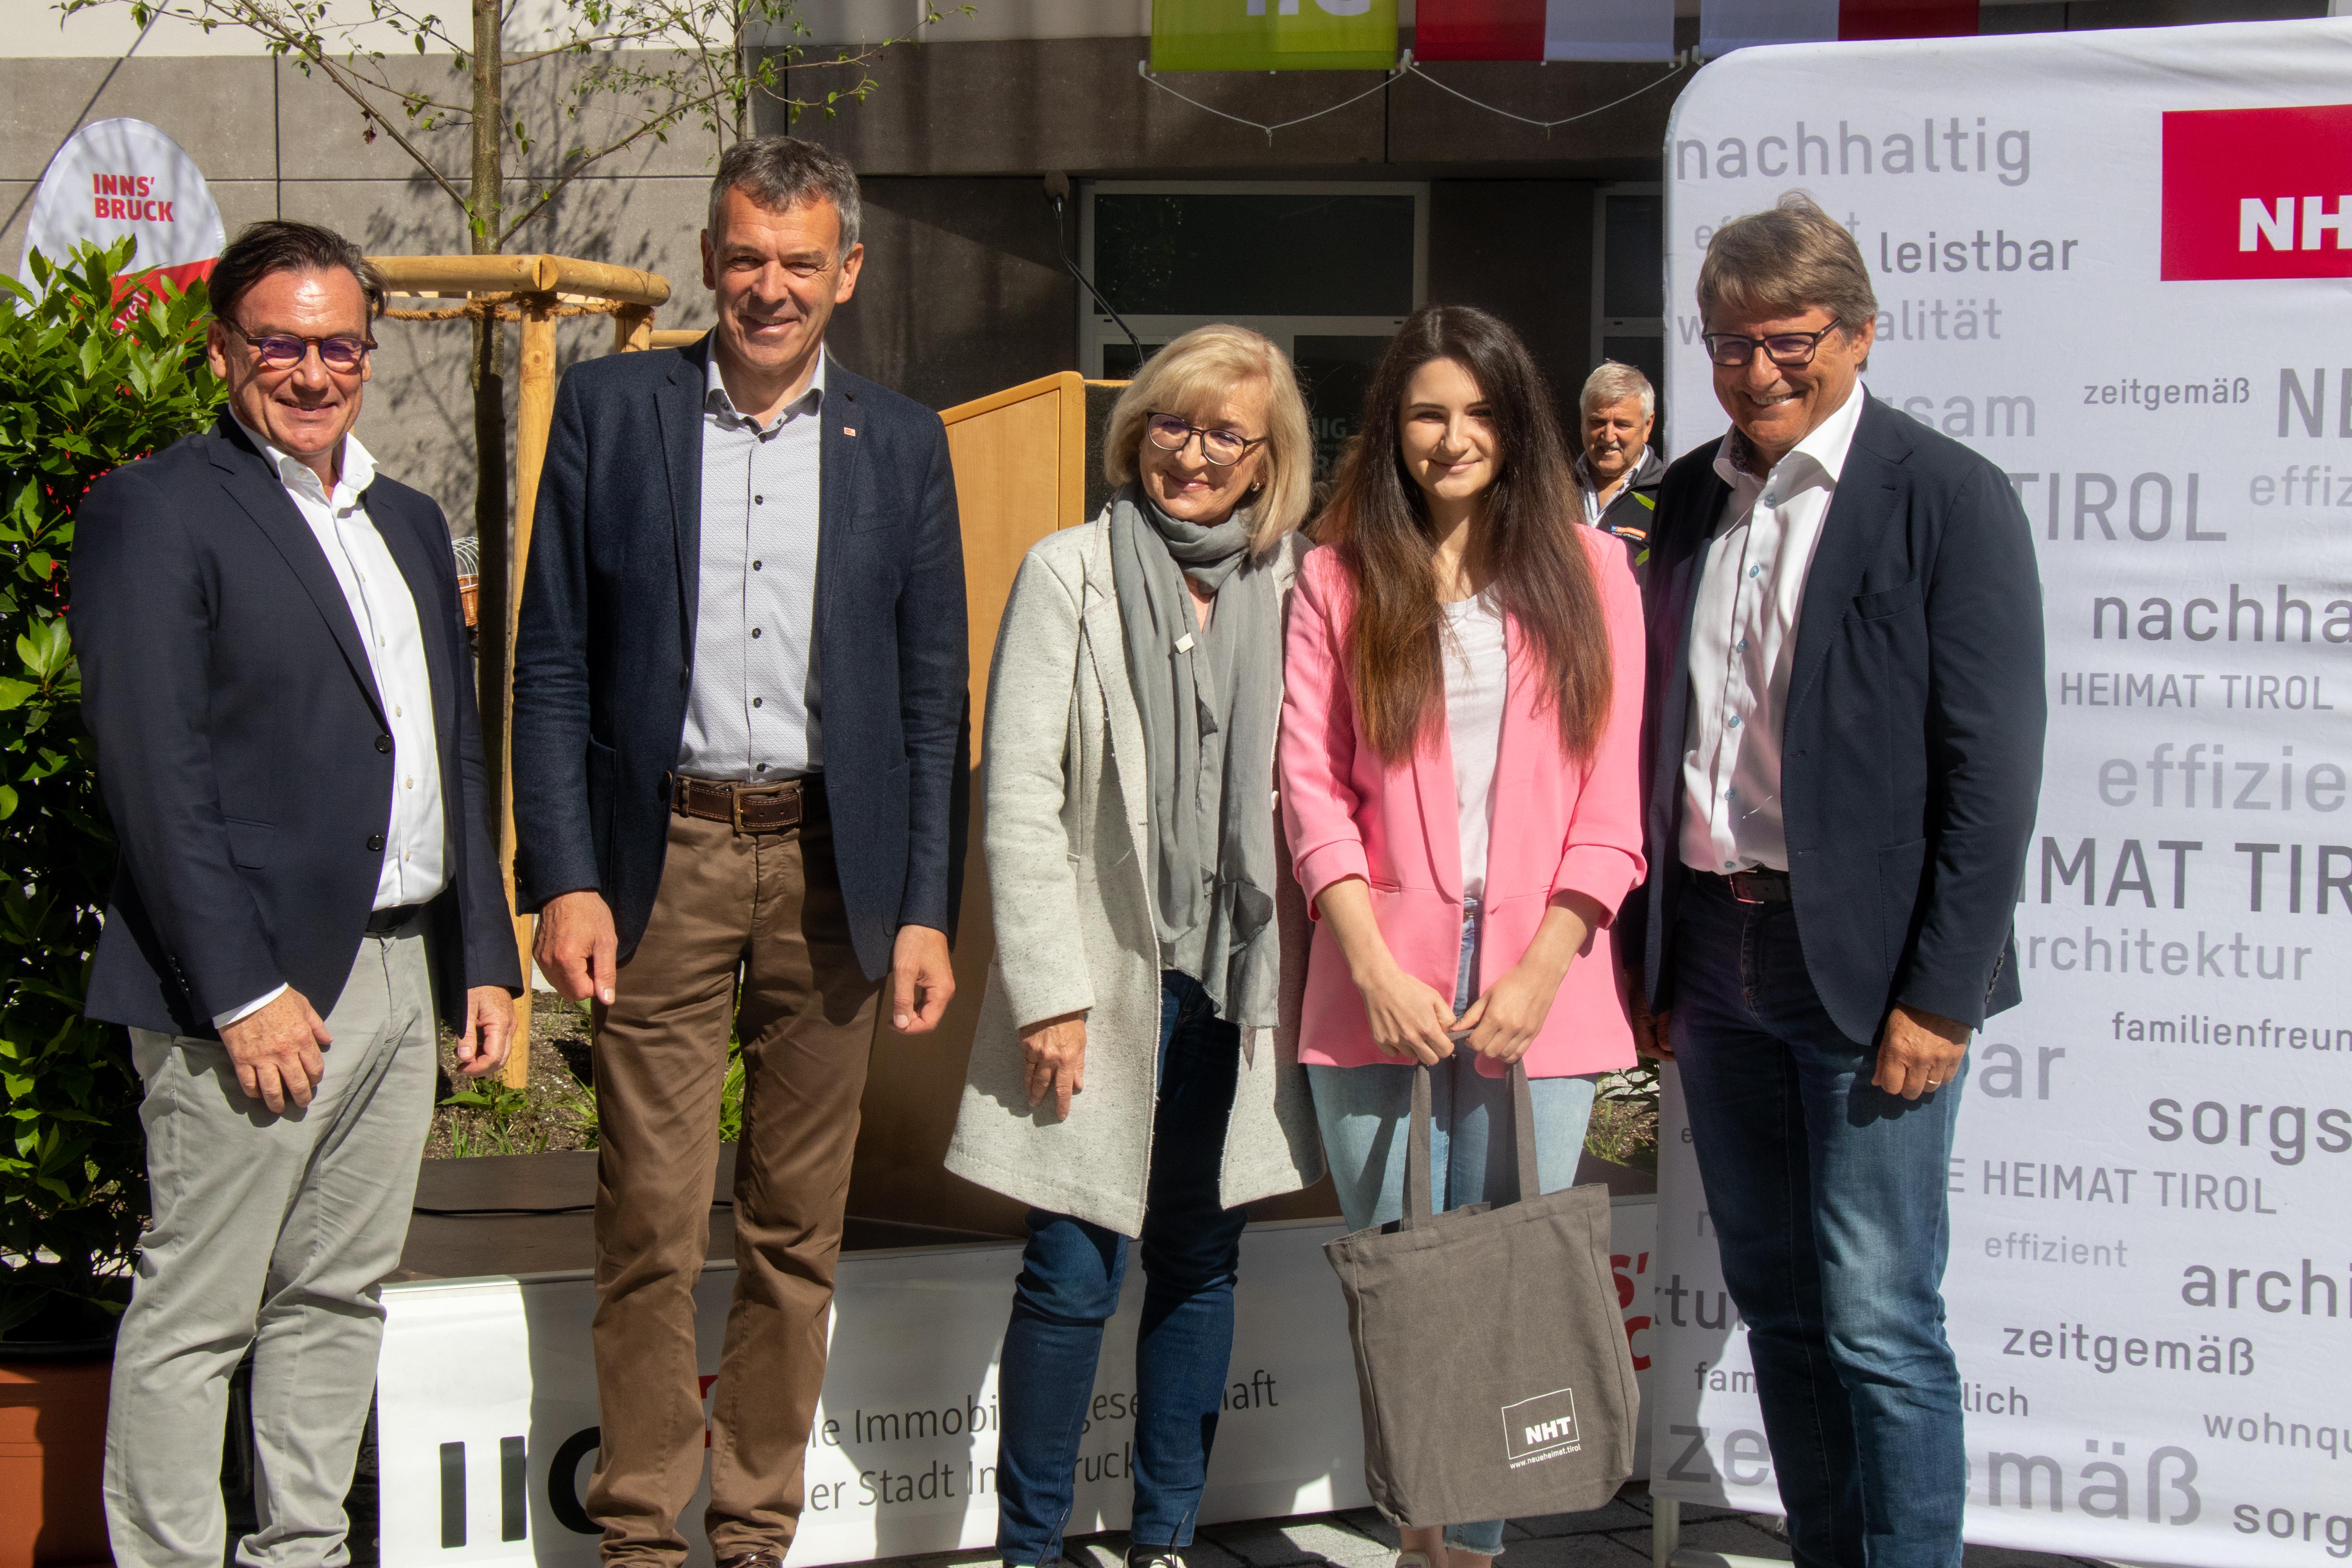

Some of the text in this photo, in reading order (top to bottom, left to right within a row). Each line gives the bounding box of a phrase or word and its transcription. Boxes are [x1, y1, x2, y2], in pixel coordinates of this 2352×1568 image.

[1677, 117, 2030, 186] nachhaltig
[94, 197, 174, 222] BRUCK
[1880, 230, 2079, 274] leistbar
[2084, 377, 2250, 410] zeitgemäß
[2061, 672, 2334, 710] HEIMAT TIROL
[2099, 743, 2346, 812] effizie
[2018, 836, 2203, 909] MAT
[2014, 926, 2312, 981] rchitektur
[1984, 1160, 2137, 1204] HEIMAT
[2153, 1171, 2277, 1215] TIROL
[1985, 1232, 2128, 1267] effizient
[2003, 1323, 2254, 1376] zeitgemäß
[1525, 1416, 1571, 1444] NHT
[1510, 1444, 1581, 1469] www.neueheimat.tirol
[858, 1460, 955, 1506] Stadt
